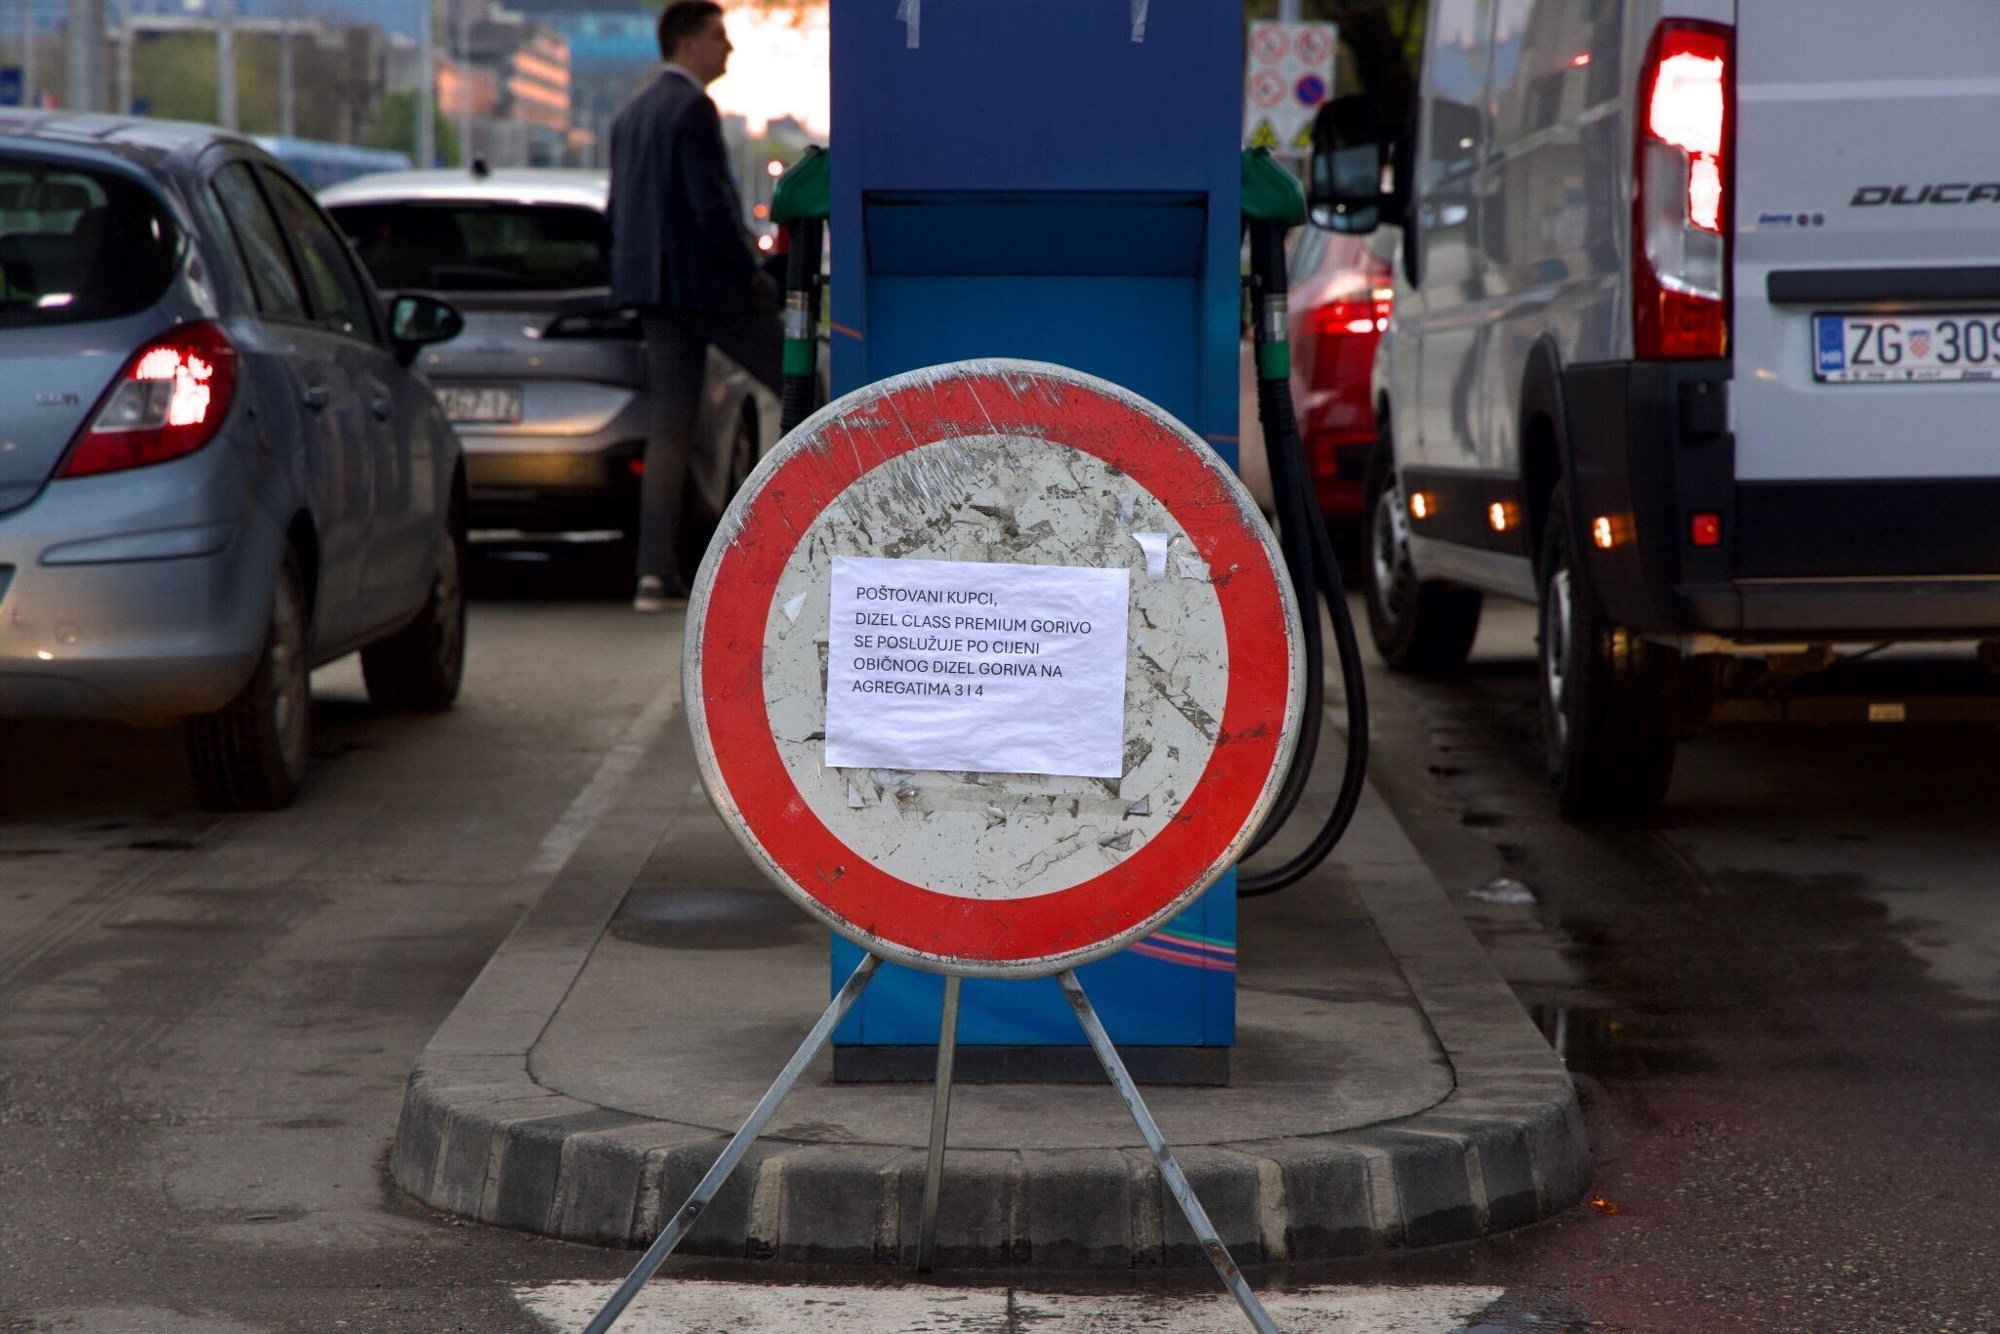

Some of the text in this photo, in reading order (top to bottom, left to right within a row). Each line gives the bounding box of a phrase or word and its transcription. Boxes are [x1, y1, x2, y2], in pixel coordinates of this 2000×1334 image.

[1850, 323, 1902, 366] ZG
[1820, 350, 1842, 364] HR
[856, 584, 998, 607] POŠTOVANI KUPCI,
[855, 611, 1092, 635] DIZEL CLASS PREMIUM GORIVO
[853, 634, 1040, 655] SE POSLUŽUJE PO CIJENI
[853, 655, 1063, 678] OBIČNOG DIZEL GORIVA NA
[851, 679, 951, 697] AGREGATIMA
[954, 683, 964, 697] 3
[974, 684, 984, 697] 4
